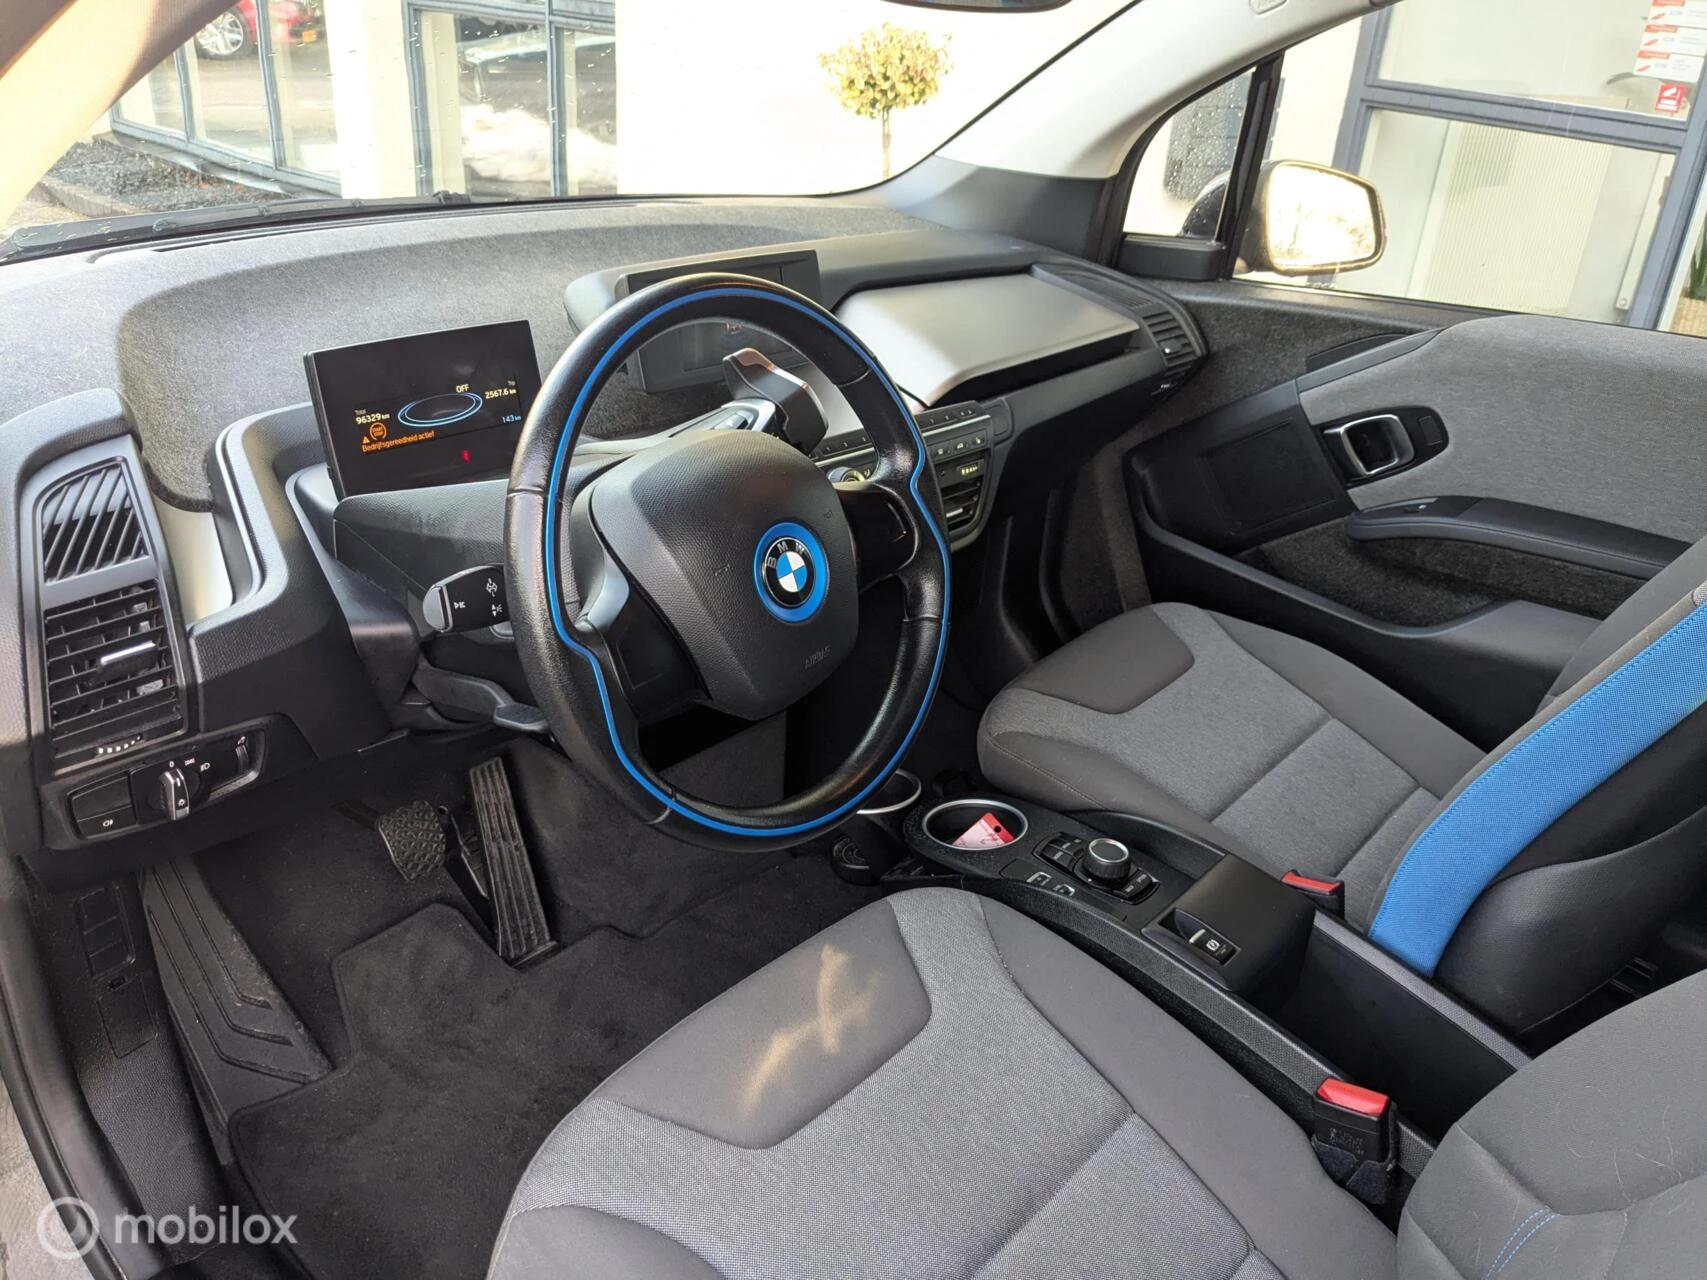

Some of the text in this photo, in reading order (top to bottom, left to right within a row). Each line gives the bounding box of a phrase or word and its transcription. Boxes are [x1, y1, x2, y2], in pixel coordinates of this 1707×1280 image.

[455, 384, 469, 393] OFF
[484, 388, 509, 399] 2567.6
[355, 413, 381, 424] 96329
[502, 414, 515, 423] 143
[767, 541, 807, 569] BMW
